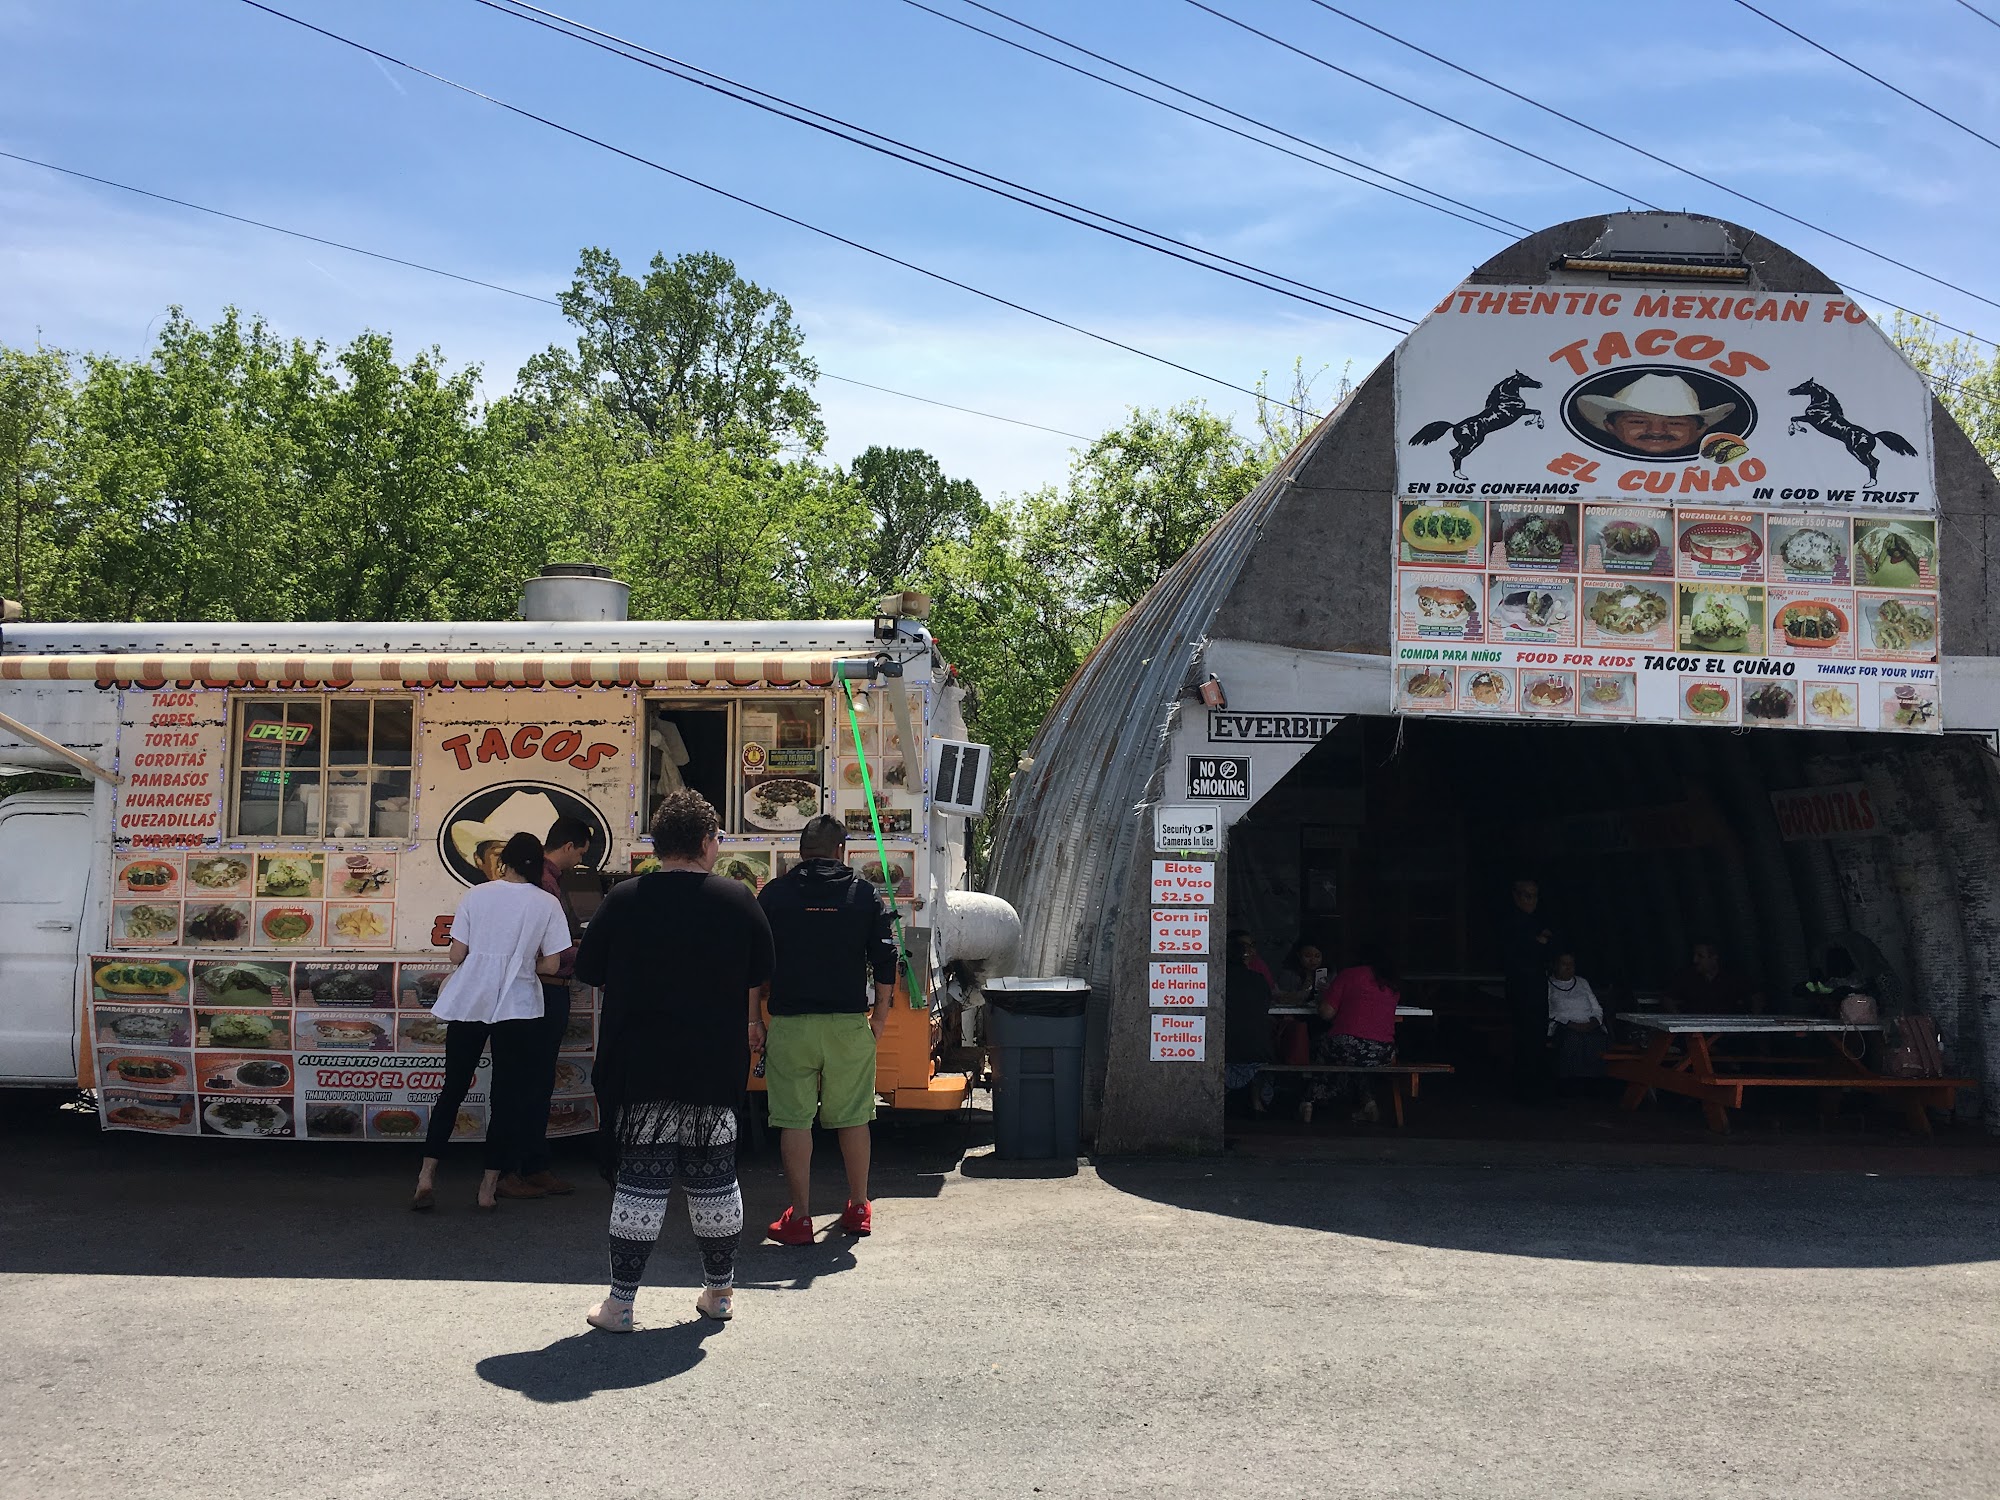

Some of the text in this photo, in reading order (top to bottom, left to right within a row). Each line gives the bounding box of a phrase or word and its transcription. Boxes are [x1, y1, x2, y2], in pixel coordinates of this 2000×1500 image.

[1632, 295, 1811, 322] MEXICAN
[1548, 328, 1771, 378] TACOS
[1546, 452, 1767, 495] EL CUÑAO
[1407, 482, 1580, 496] EN DIOS CONFIAMOS
[1752, 487, 1920, 505] IN GOD WE TRUST
[1498, 503, 1566, 515] SOPES $2.00 EACH
[1585, 506, 1622, 518] GORDITAS
[1646, 509, 1667, 520] EACH
[1679, 512, 1726, 522] QUEZADILLA
[1768, 516, 1846, 529] HUARACHE $5.00 EACH
[1400, 648, 1503, 663] COMIDA PARA NIÑOS
[1516, 652, 1636, 668] FOOD FOR KIDS
[1644, 655, 1796, 676] TACOS EL CUÑAO
[1817, 664, 1936, 680] THANKS FOR YOUR VISIT
[151, 693, 195, 707] TACOS
[150, 713, 195, 727] SOPES
[144, 732, 199, 747] TORTAS
[248, 724, 310, 742] OPEN
[441, 725, 619, 770] TACOS
[134, 753, 206, 767] GORDITAS
[1199, 760, 1215, 777] NO
[130, 772, 209, 787] PAMBASOS
[1192, 779, 1245, 796] SMOKING
[125, 792, 212, 807] HUARACHES
[120, 812, 217, 828] QUEZADILLAS
[1162, 824, 1192, 836] Security
[1162, 836, 1214, 847] Cameras In Use
[1164, 862, 1203, 874] Elote
[1154, 877, 1212, 888] en Vaso
[1161, 891, 1205, 903] $2.50
[1152, 911, 1208, 922] Corn in
[1173, 929, 1202, 938] cup
[1158, 941, 1203, 951] $2.50
[305, 963, 380, 972] SOPES $2.00 EACH
[1159, 964, 1198, 975] Tortilla
[1151, 979, 1206, 990] de Harina
[1163, 995, 1195, 1005] $2.00
[95, 1005, 134, 1014] HUARACHE
[136, 1007, 161, 1015] $5.00
[1162, 1017, 1195, 1028] Flour
[1153, 1031, 1203, 1043] Tortillas
[1160, 1047, 1196, 1058] $2.00
[298, 1055, 379, 1068] AUTHENTIC
[379, 1056, 446, 1069] MEXICAN
[317, 1070, 378, 1088] TACOS
[378, 1071, 405, 1089] EL
[202, 1096, 282, 1105] ASADA FRIES
[305, 1091, 392, 1102] THANK YOU FOR YOUR VISIT
[407, 1092, 437, 1103] GRACIAS
